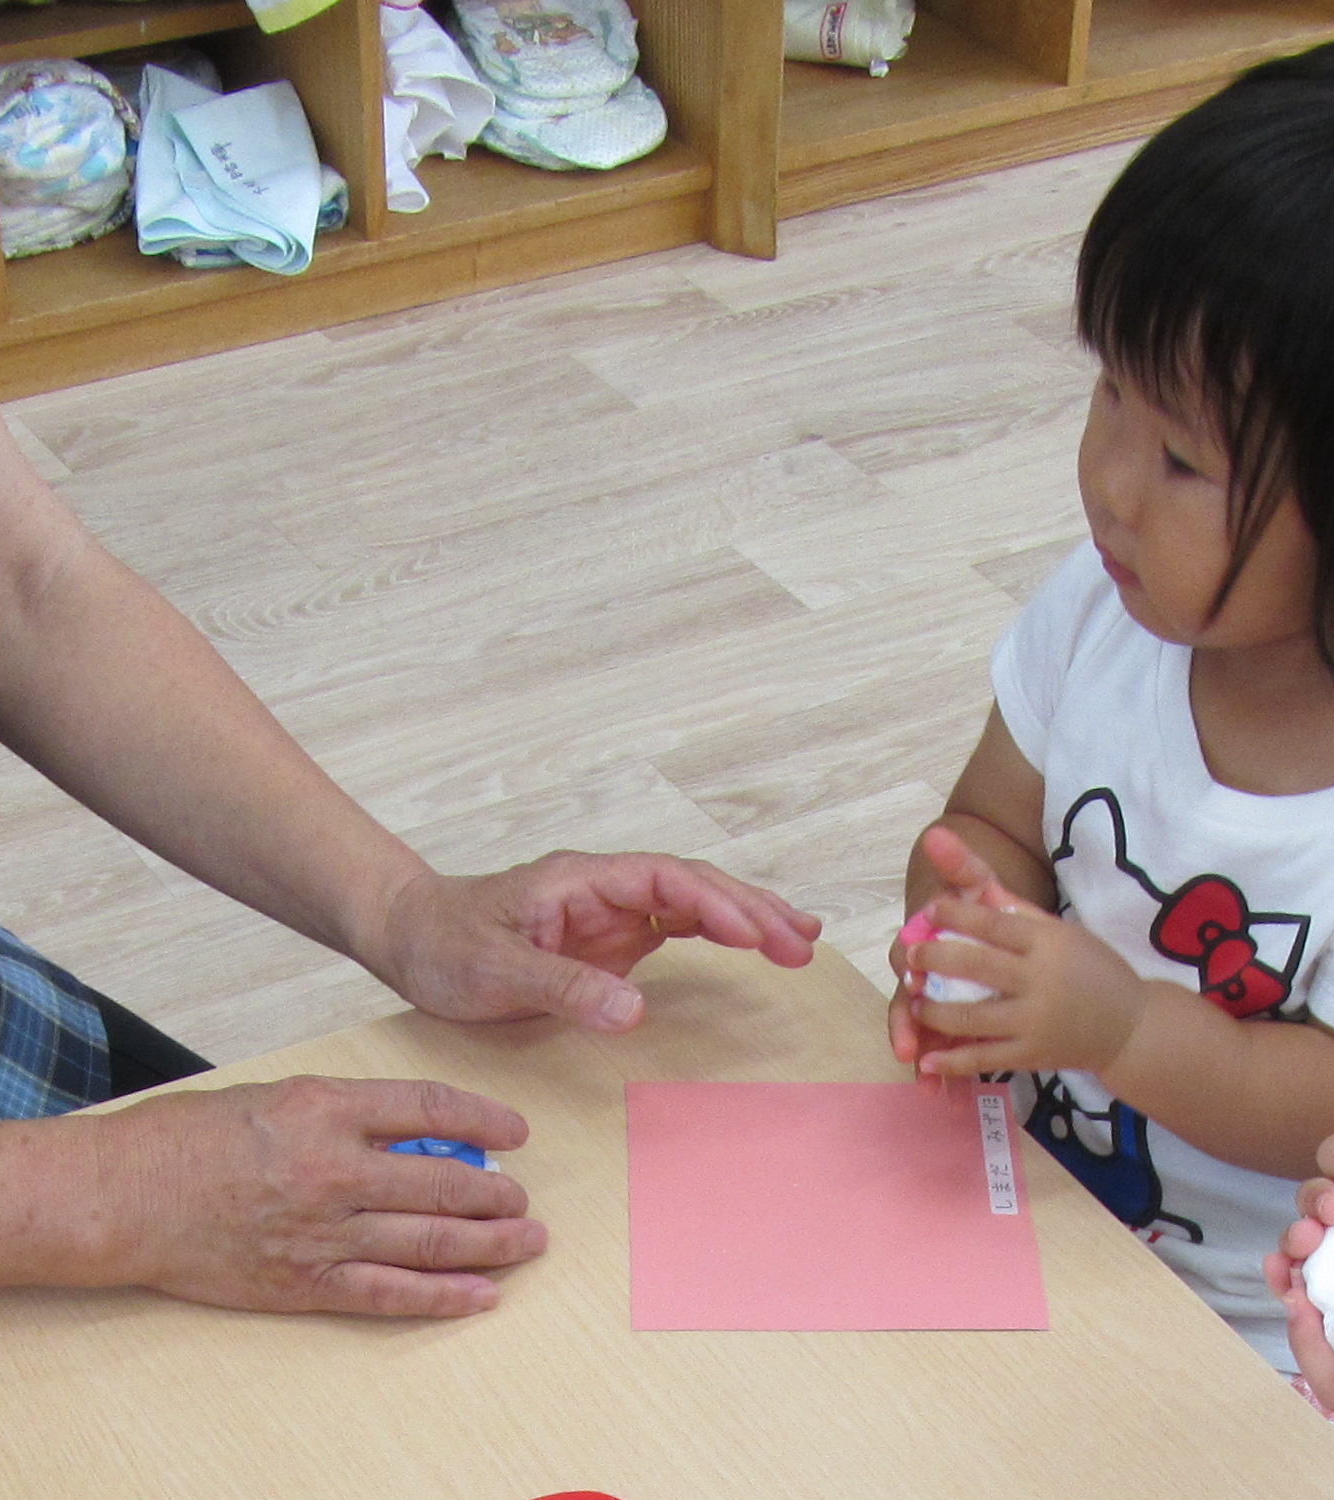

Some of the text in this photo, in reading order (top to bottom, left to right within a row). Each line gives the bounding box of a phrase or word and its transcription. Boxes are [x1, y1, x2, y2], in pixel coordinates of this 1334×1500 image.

[981, 1097, 1014, 1210] しまだ みずほ
